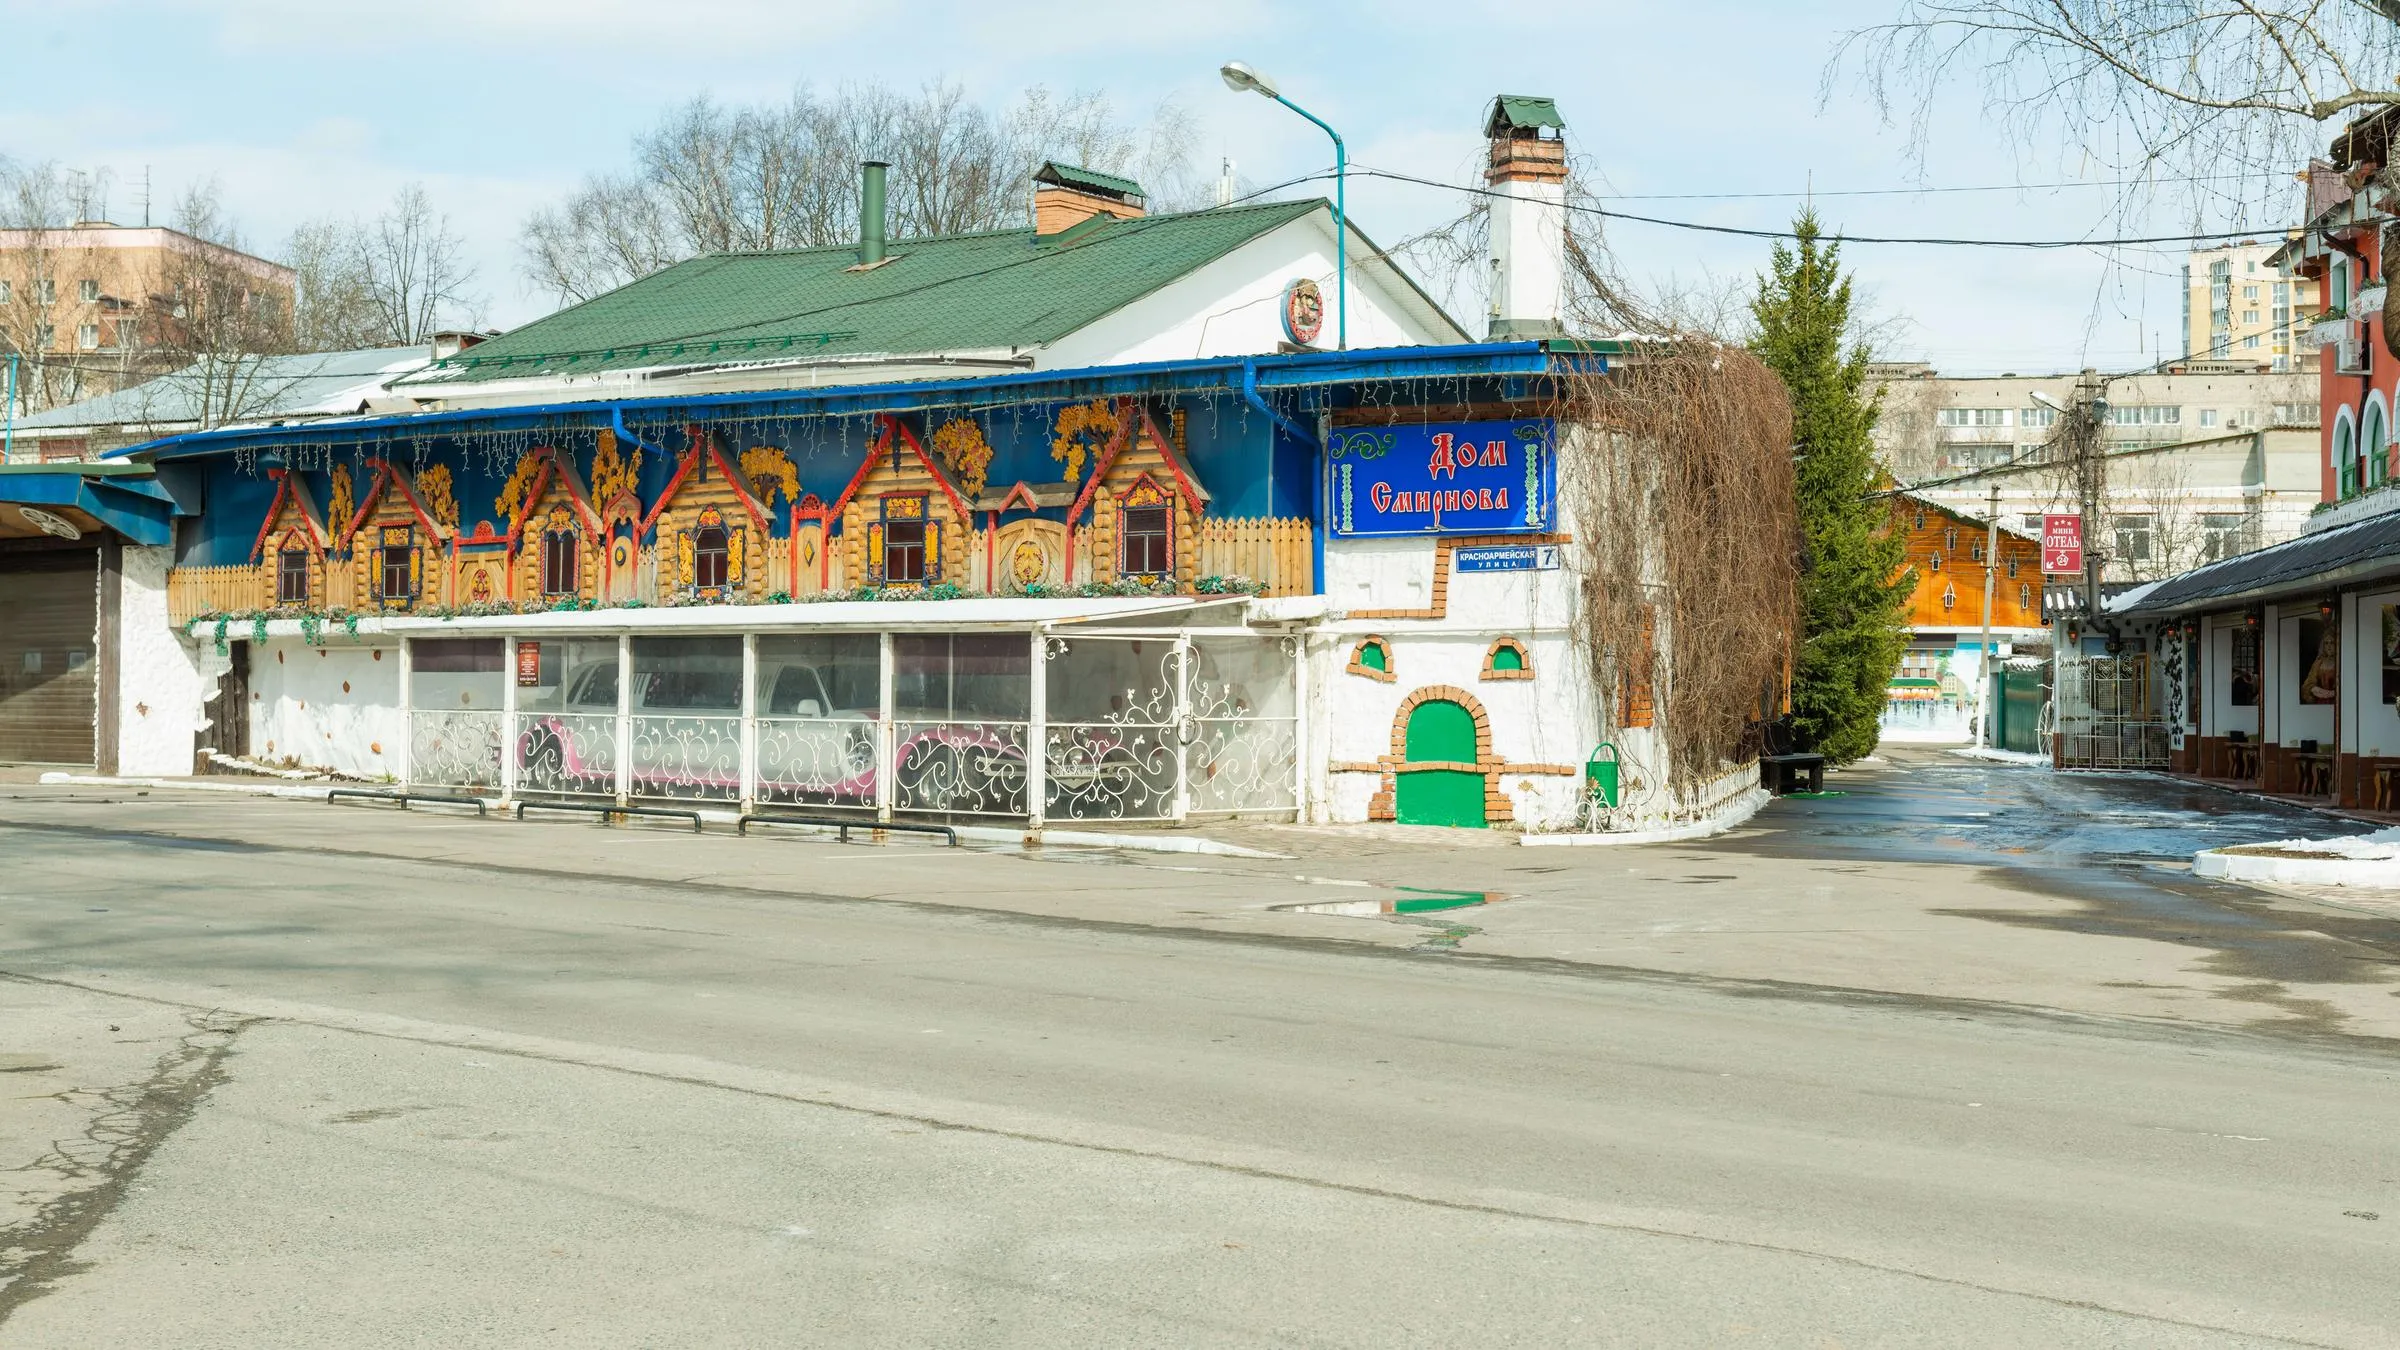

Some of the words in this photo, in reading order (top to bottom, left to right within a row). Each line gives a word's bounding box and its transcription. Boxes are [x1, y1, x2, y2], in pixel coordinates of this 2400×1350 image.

[1428, 433, 1508, 480] Дом
[1371, 481, 1509, 527] Смирнова
[2046, 535, 2079, 548] ОТЕЛЬ
[1460, 550, 1535, 561] КРАСНОАРМЕЙСКАЯ
[1543, 549, 1554, 565] 7
[1478, 561, 1517, 569] УЛИЦА
